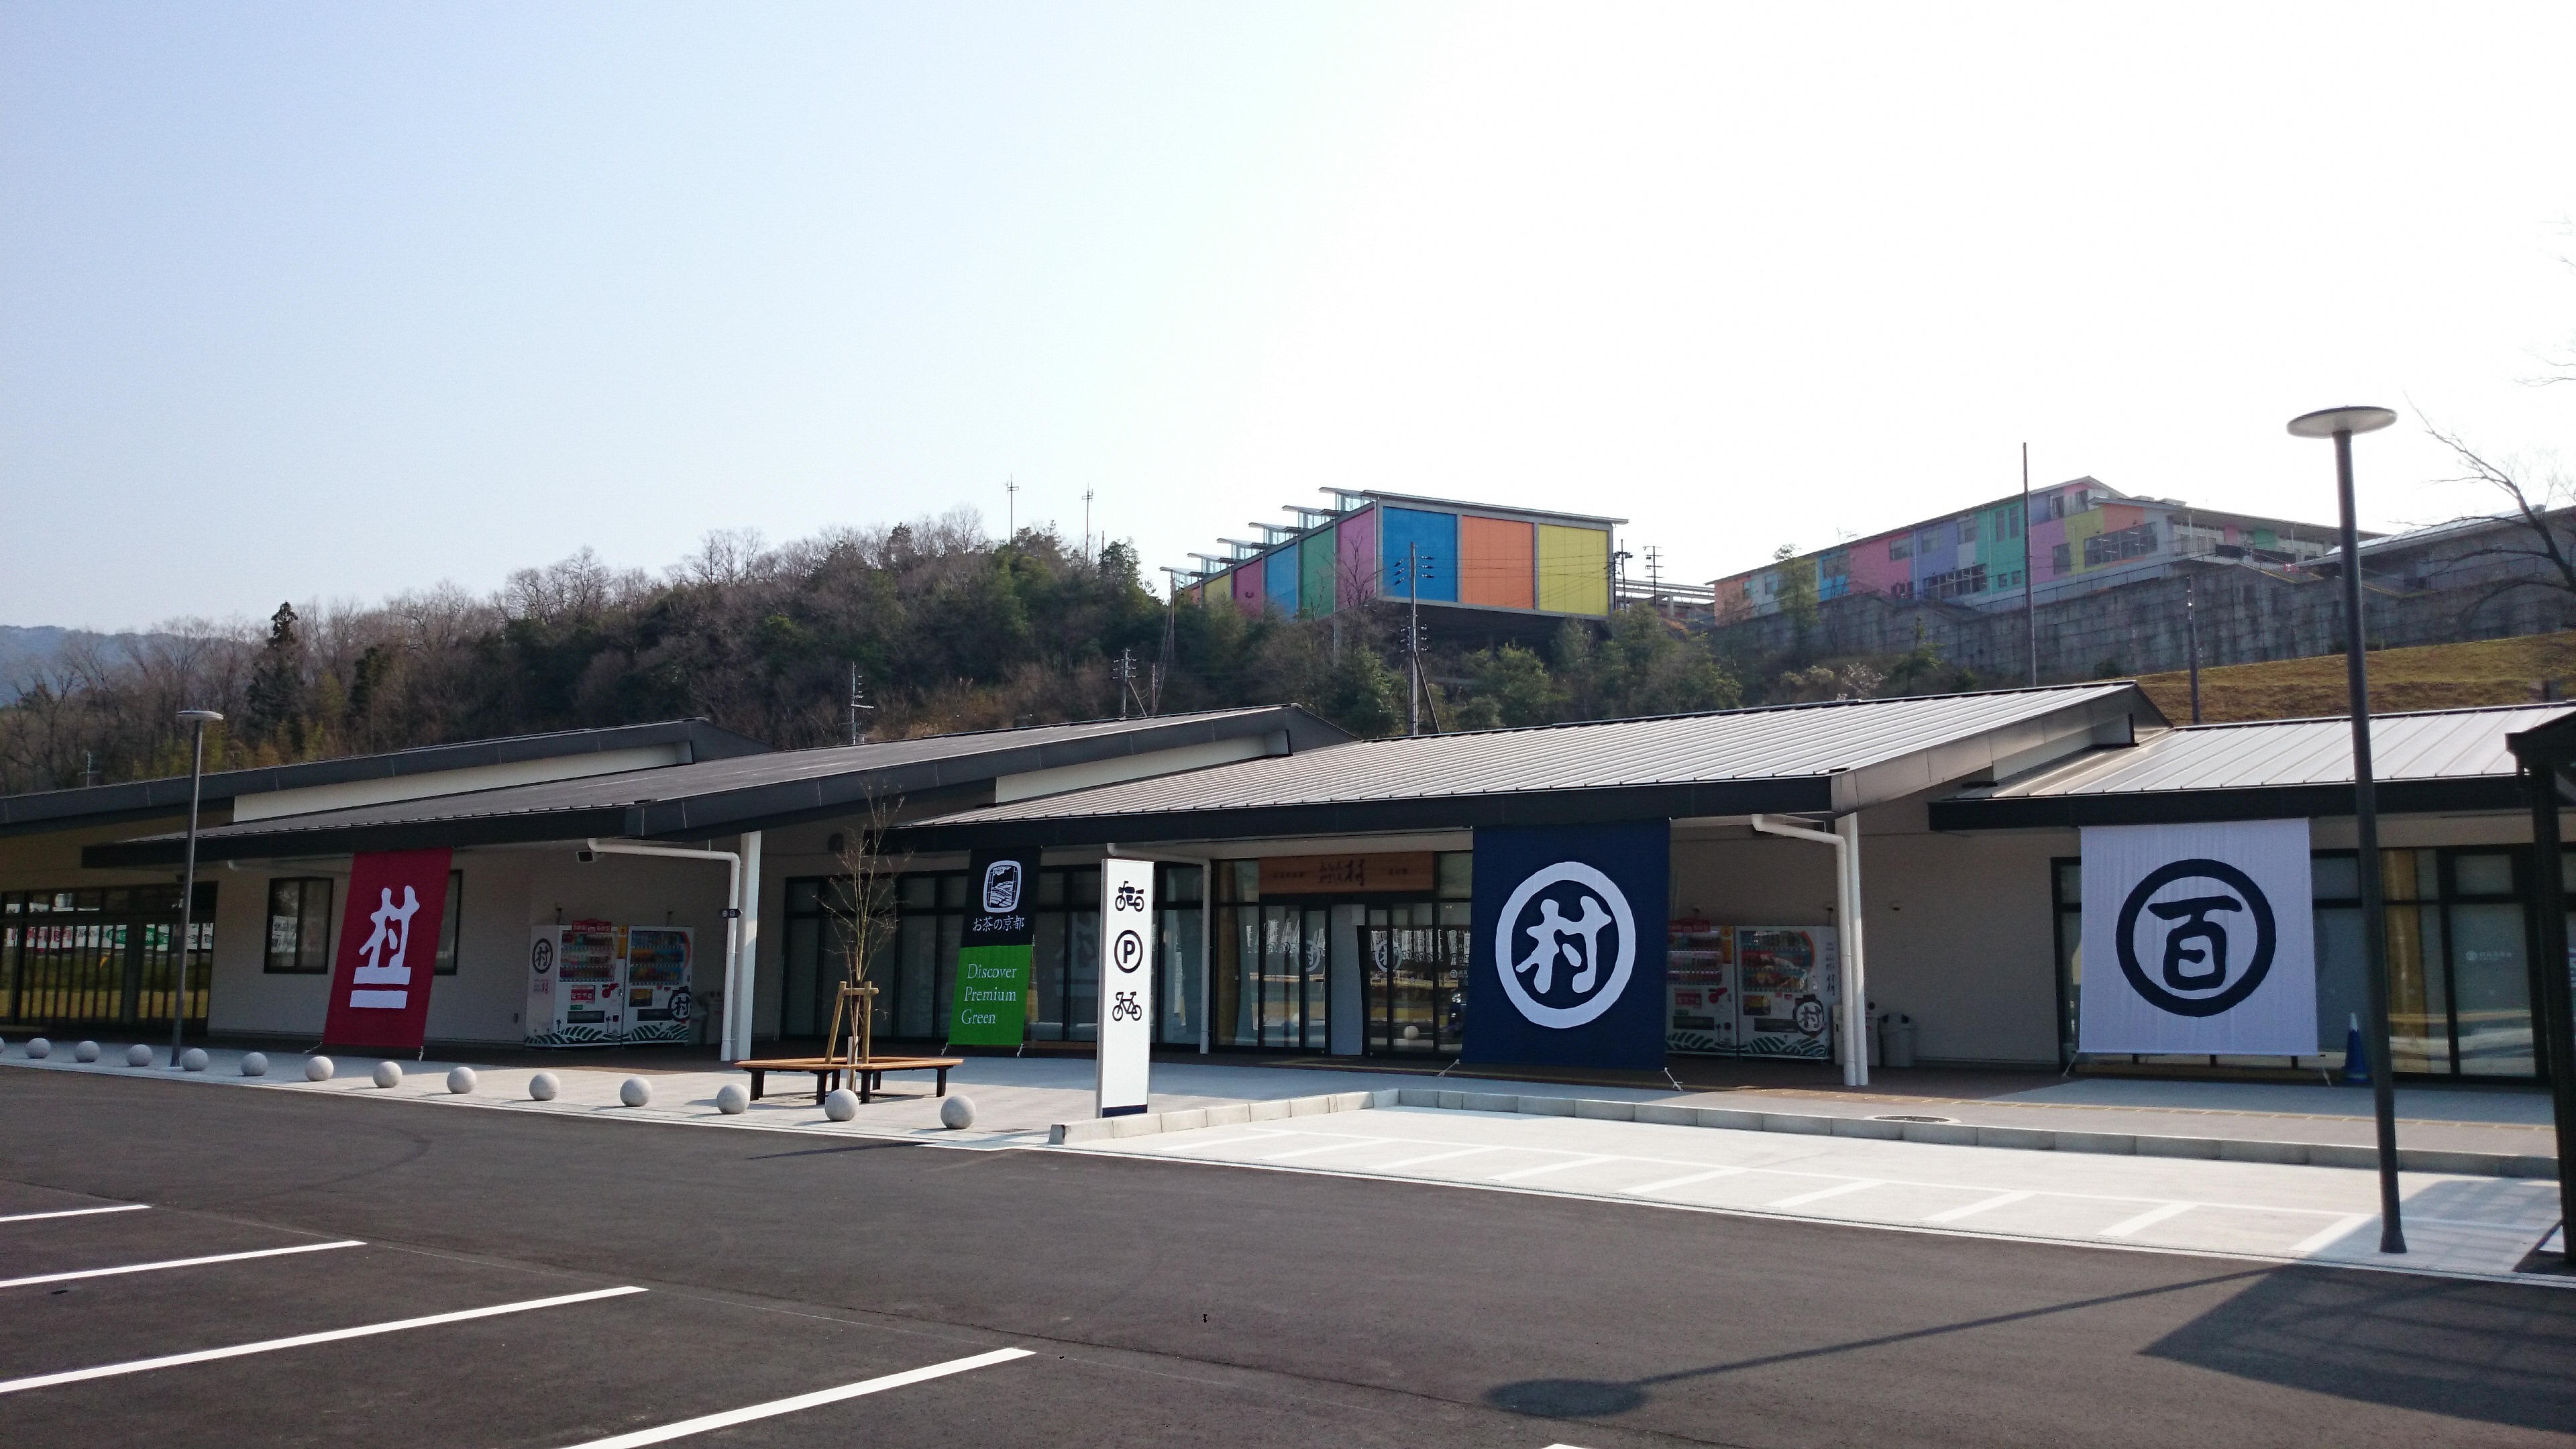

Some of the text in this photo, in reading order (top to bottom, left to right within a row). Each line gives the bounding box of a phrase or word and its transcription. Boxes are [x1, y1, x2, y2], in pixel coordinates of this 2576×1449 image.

[973, 915, 1025, 932] お茶の京都
[1123, 940, 1136, 964] P
[1515, 896, 1612, 994] 村
[2147, 895, 2243, 991] 百
[535, 946, 550, 967] 村
[967, 963, 1017, 979] Discover
[964, 986, 1016, 1002] Premium
[675, 996, 691, 1016] 村
[961, 1009, 996, 1024] Green
[1801, 1006, 1823, 1030] 村
